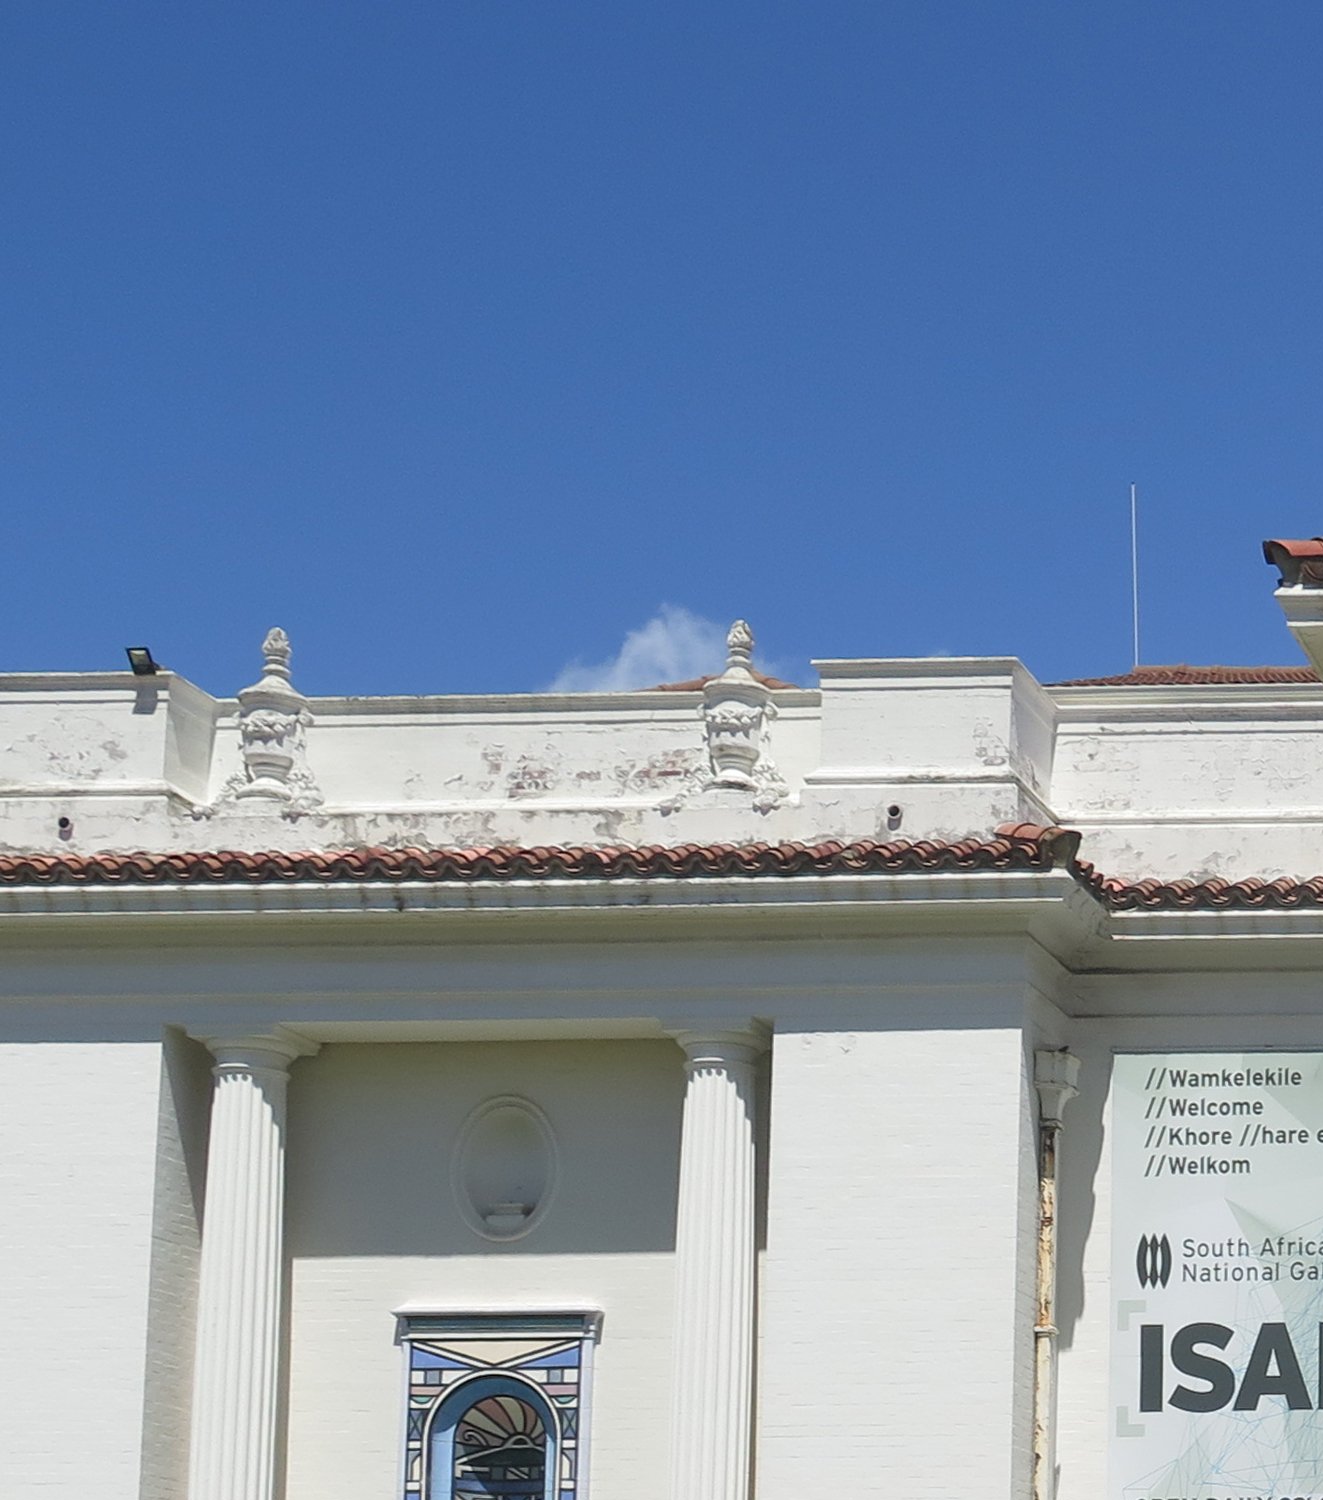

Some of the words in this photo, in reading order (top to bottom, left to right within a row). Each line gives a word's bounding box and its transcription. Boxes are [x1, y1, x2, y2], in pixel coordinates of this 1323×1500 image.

[1144, 1067, 1303, 1091] //Wamkelekile
[1144, 1096, 1264, 1120] //Welcome
[1144, 1125, 1233, 1149] //Khore
[1238, 1123, 1310, 1148] //hare
[1144, 1154, 1251, 1178] //Welkom
[1182, 1238, 1250, 1258] South
[1181, 1262, 1280, 1283] National
